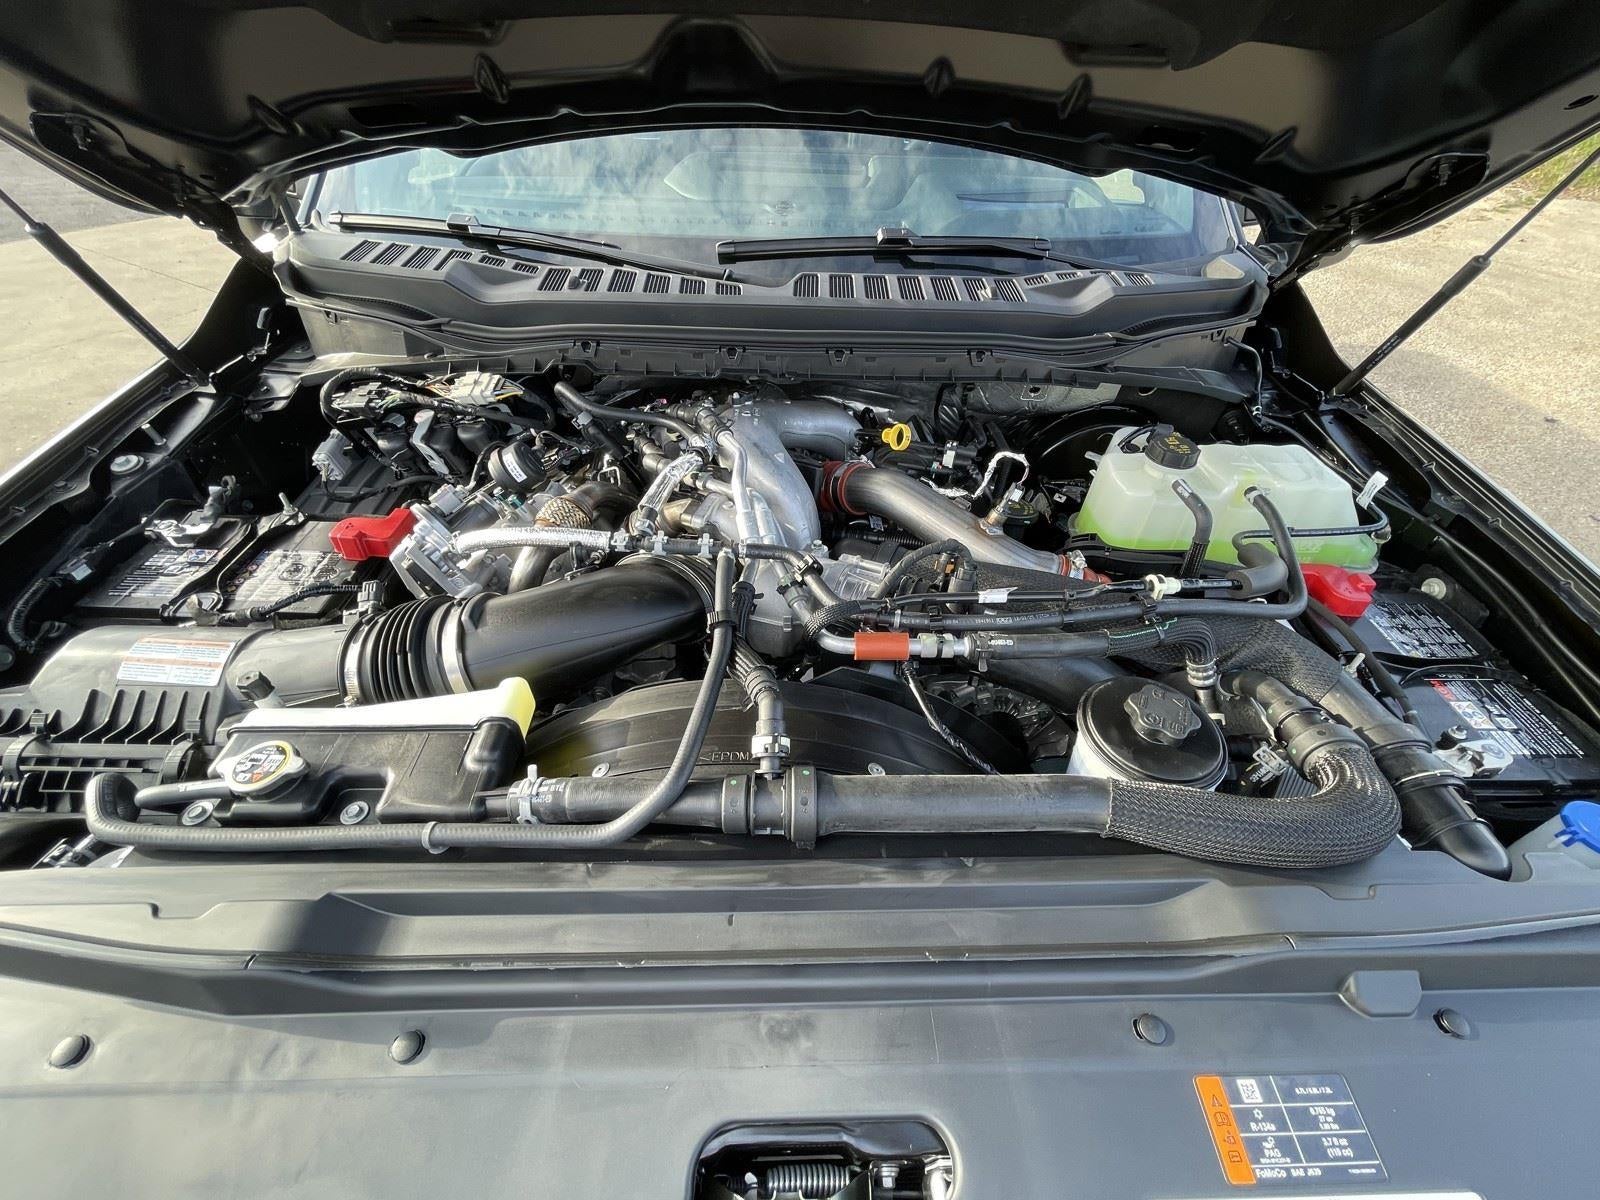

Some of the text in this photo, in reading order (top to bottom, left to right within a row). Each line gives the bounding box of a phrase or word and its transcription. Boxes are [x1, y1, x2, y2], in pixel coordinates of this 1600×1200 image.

[1249, 1121, 1277, 1132] R-134a
[1264, 1148, 1282, 1158] PAG
[1255, 1168, 1287, 1178] FoMoCo
